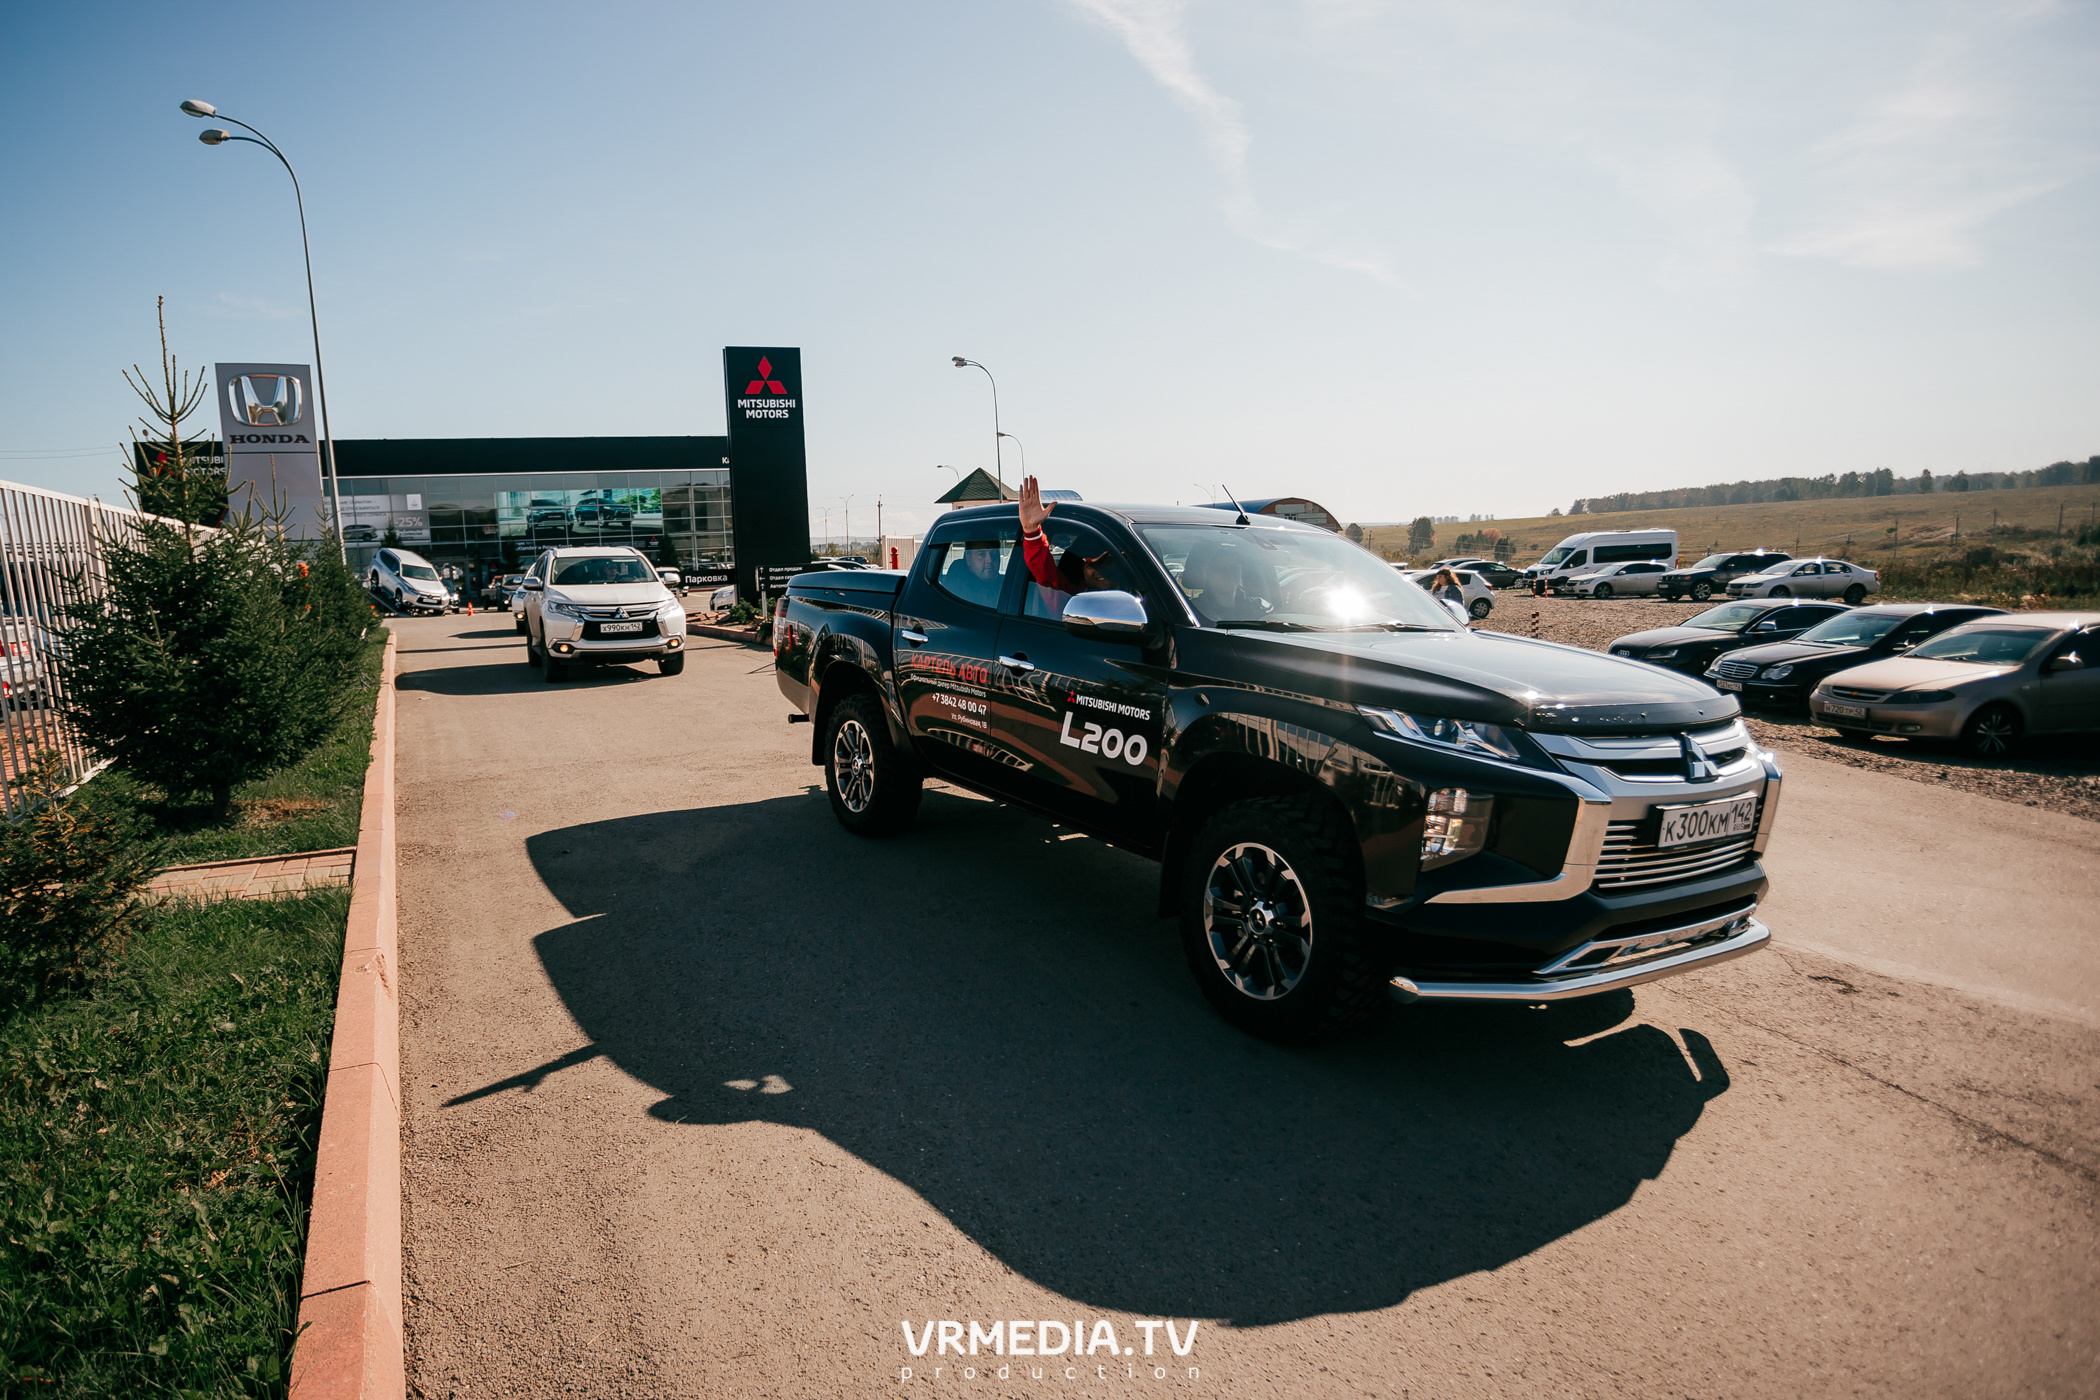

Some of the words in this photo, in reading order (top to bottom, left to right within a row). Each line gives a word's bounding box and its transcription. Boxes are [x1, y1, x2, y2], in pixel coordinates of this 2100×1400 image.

[737, 399, 796, 408] MITSUBISHI
[745, 409, 789, 419] MOTORS
[229, 433, 311, 444] HONDA
[685, 574, 728, 584] Парковка
[910, 653, 957, 677] КАРТЕЛЬ
[958, 663, 988, 684] АВТО
[949, 682, 971, 694] Mitsubishi
[970, 687, 987, 698] Motors
[932, 692, 940, 703] +7
[940, 693, 957, 708] 3842
[957, 698, 967, 710] 48
[967, 701, 977, 713] 00
[977, 704, 987, 716] 47
[1075, 694, 1118, 713] MITSUBISHI
[1117, 703, 1151, 721] MOTORS
[1060, 710, 1148, 766] L200
